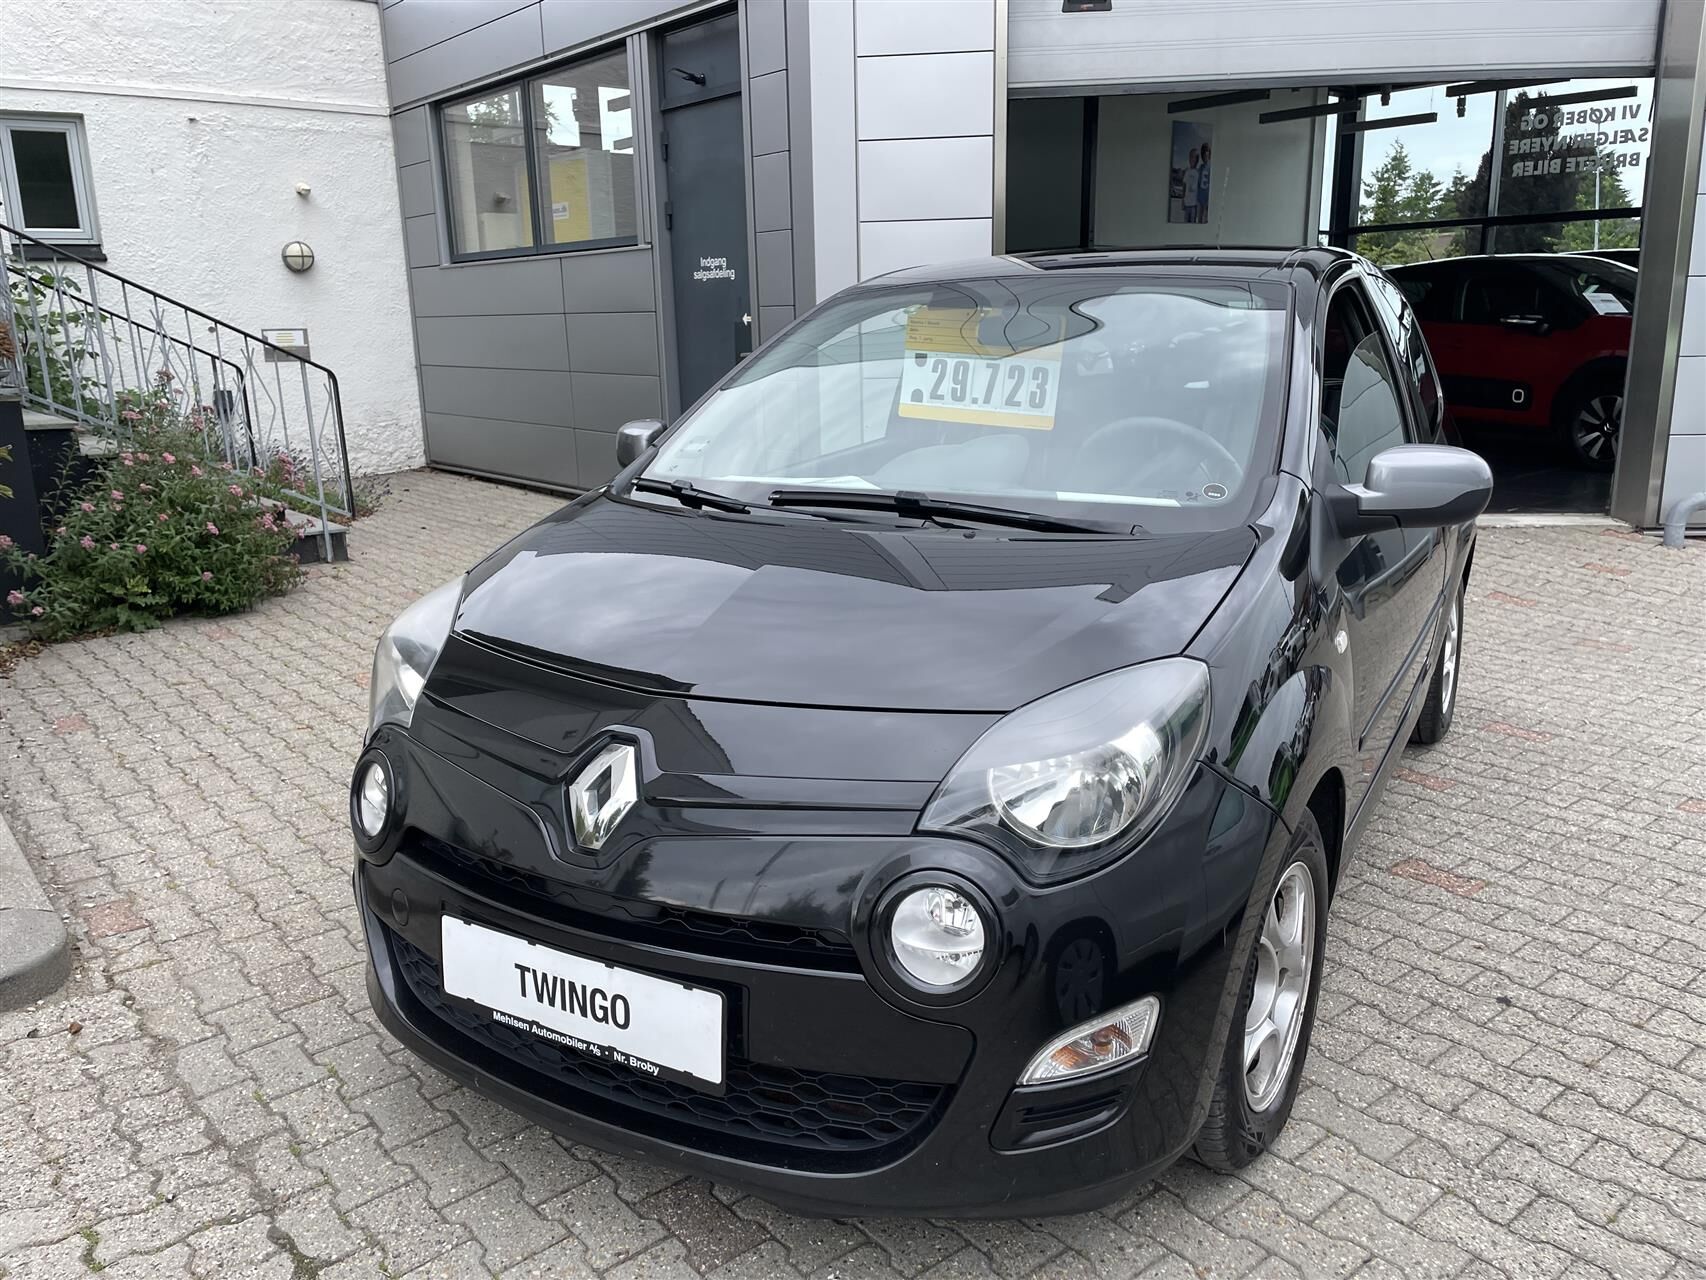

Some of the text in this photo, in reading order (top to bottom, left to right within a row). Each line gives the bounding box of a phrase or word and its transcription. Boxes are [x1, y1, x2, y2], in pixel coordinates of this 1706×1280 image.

[700, 256, 727, 270] Indgang
[929, 358, 1050, 409] 29.723
[514, 962, 631, 1030] TWINGO
[492, 1010, 530, 1032] Mehlsen
[531, 1023, 588, 1051] Automobiler
[613, 1051, 628, 1065] Nr.
[629, 1055, 660, 1076] Broby
